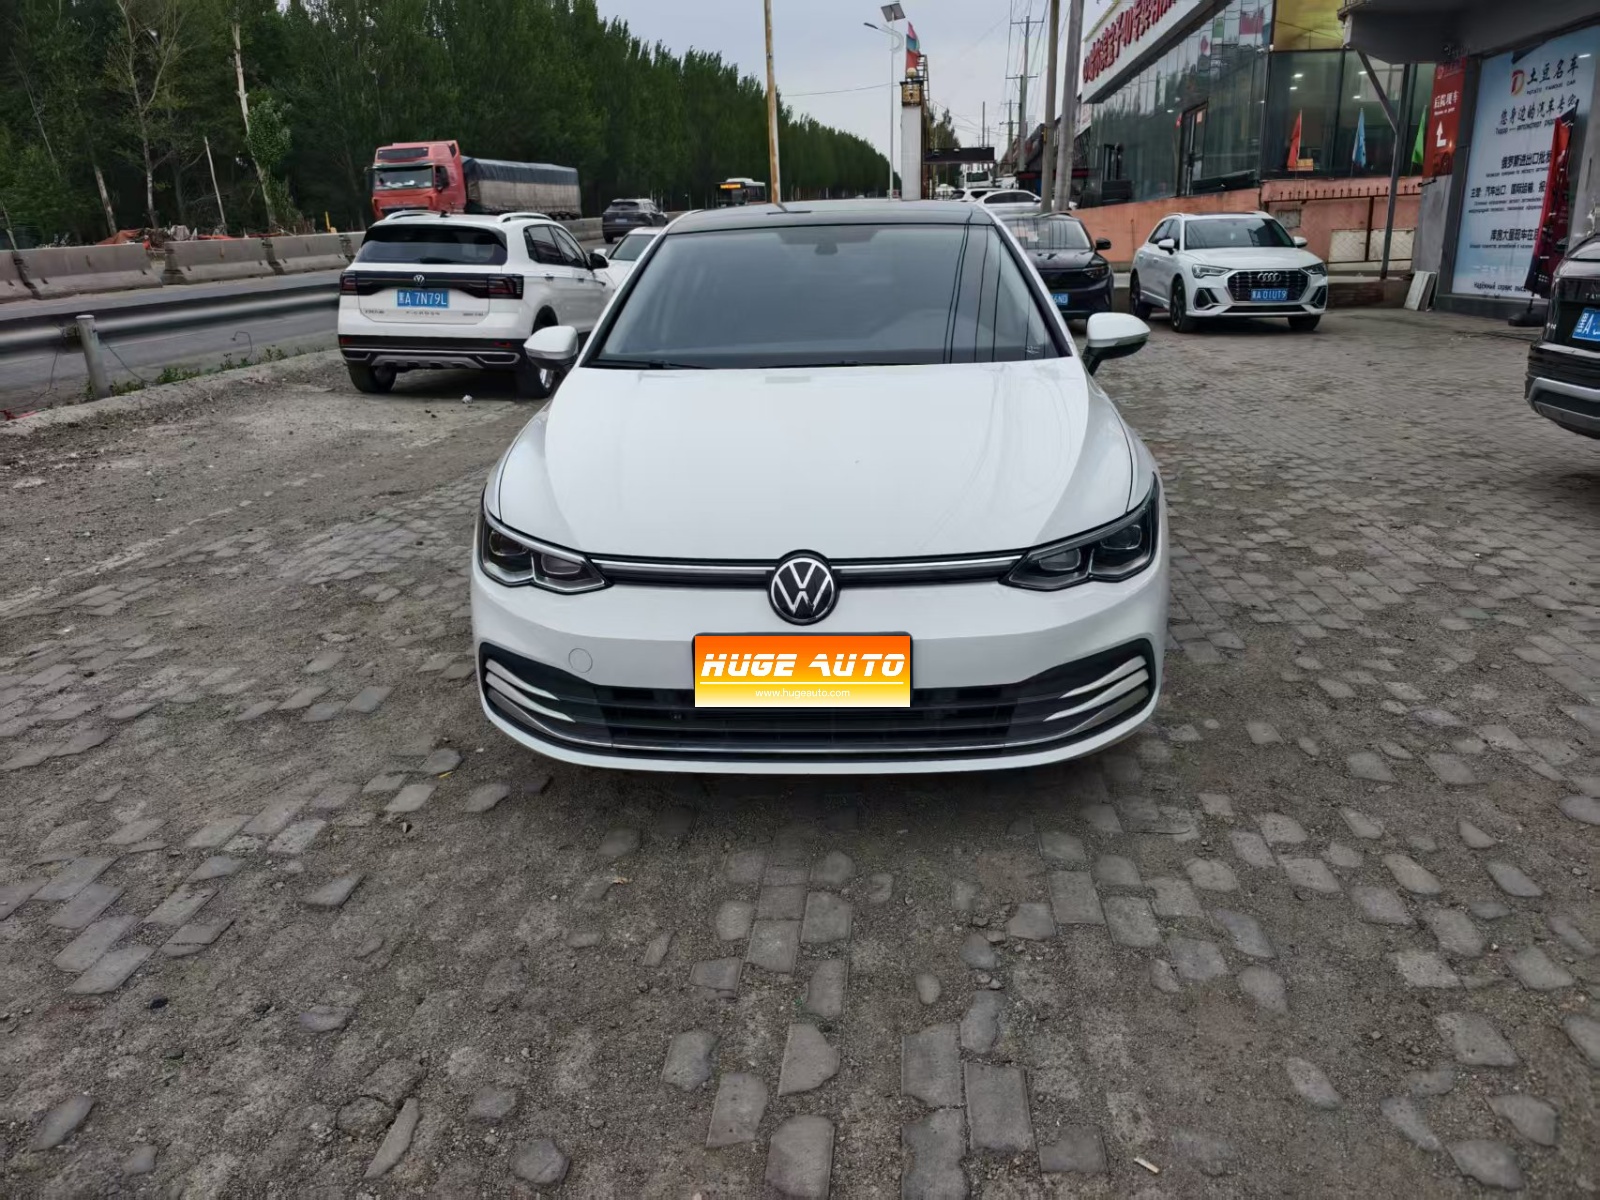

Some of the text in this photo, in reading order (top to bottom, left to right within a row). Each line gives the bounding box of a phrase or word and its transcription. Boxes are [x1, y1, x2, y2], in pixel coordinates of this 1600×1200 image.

[1527, 53, 1579, 85] 土豆名车
[416, 292, 447, 305] 7N79L
